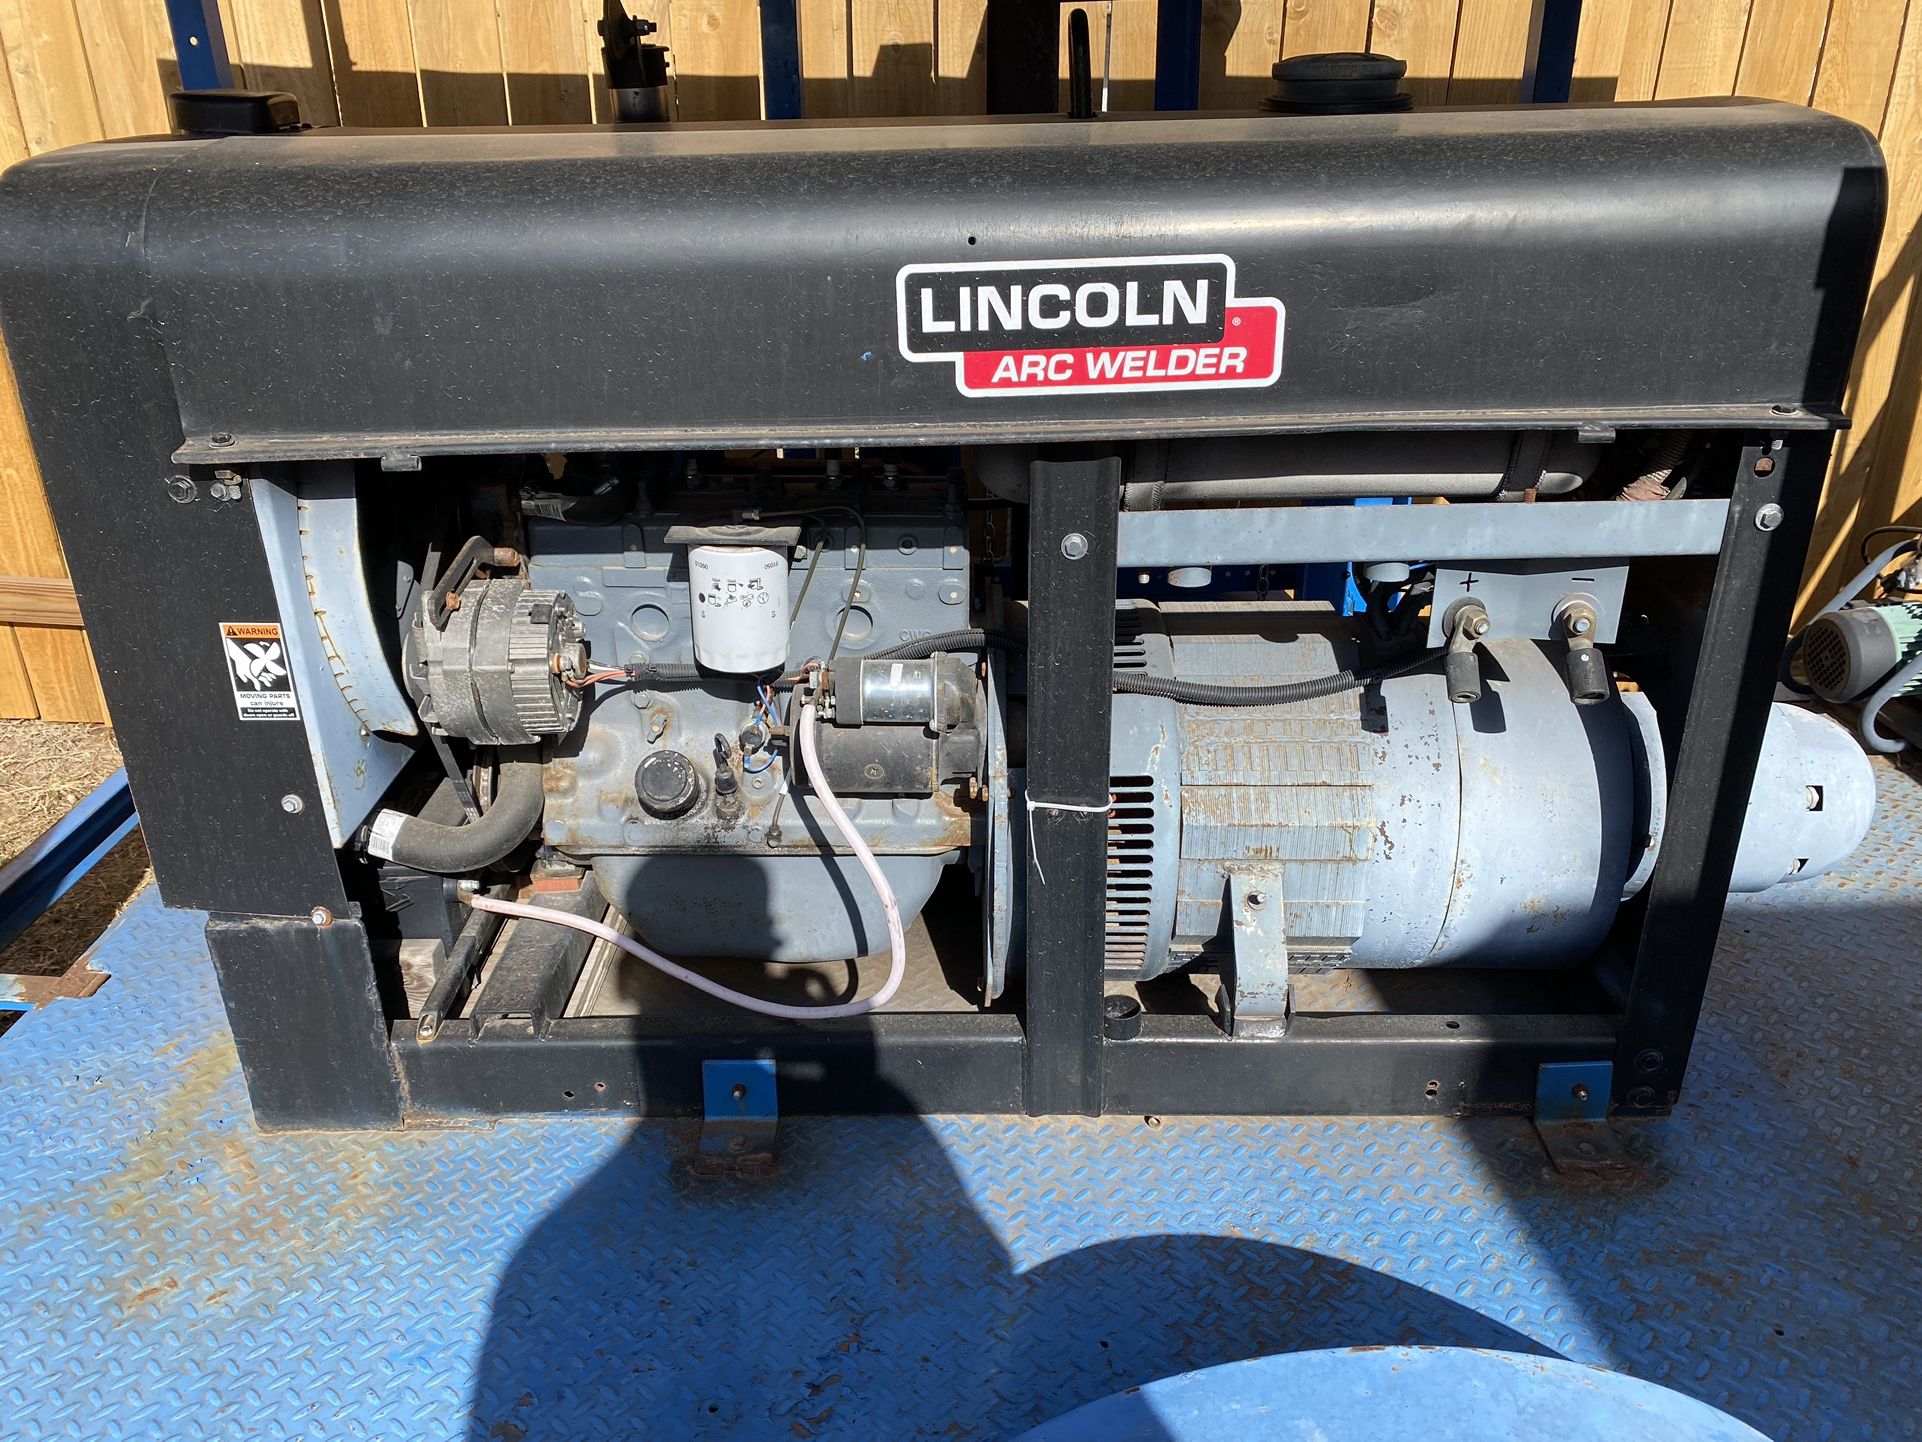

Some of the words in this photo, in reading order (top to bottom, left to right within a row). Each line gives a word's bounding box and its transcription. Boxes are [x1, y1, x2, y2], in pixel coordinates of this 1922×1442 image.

[920, 279, 1208, 333] LINCOLN
[991, 353, 1074, 383] ARC
[1084, 347, 1247, 380] WELDER
[237, 627, 278, 636] WARNING
